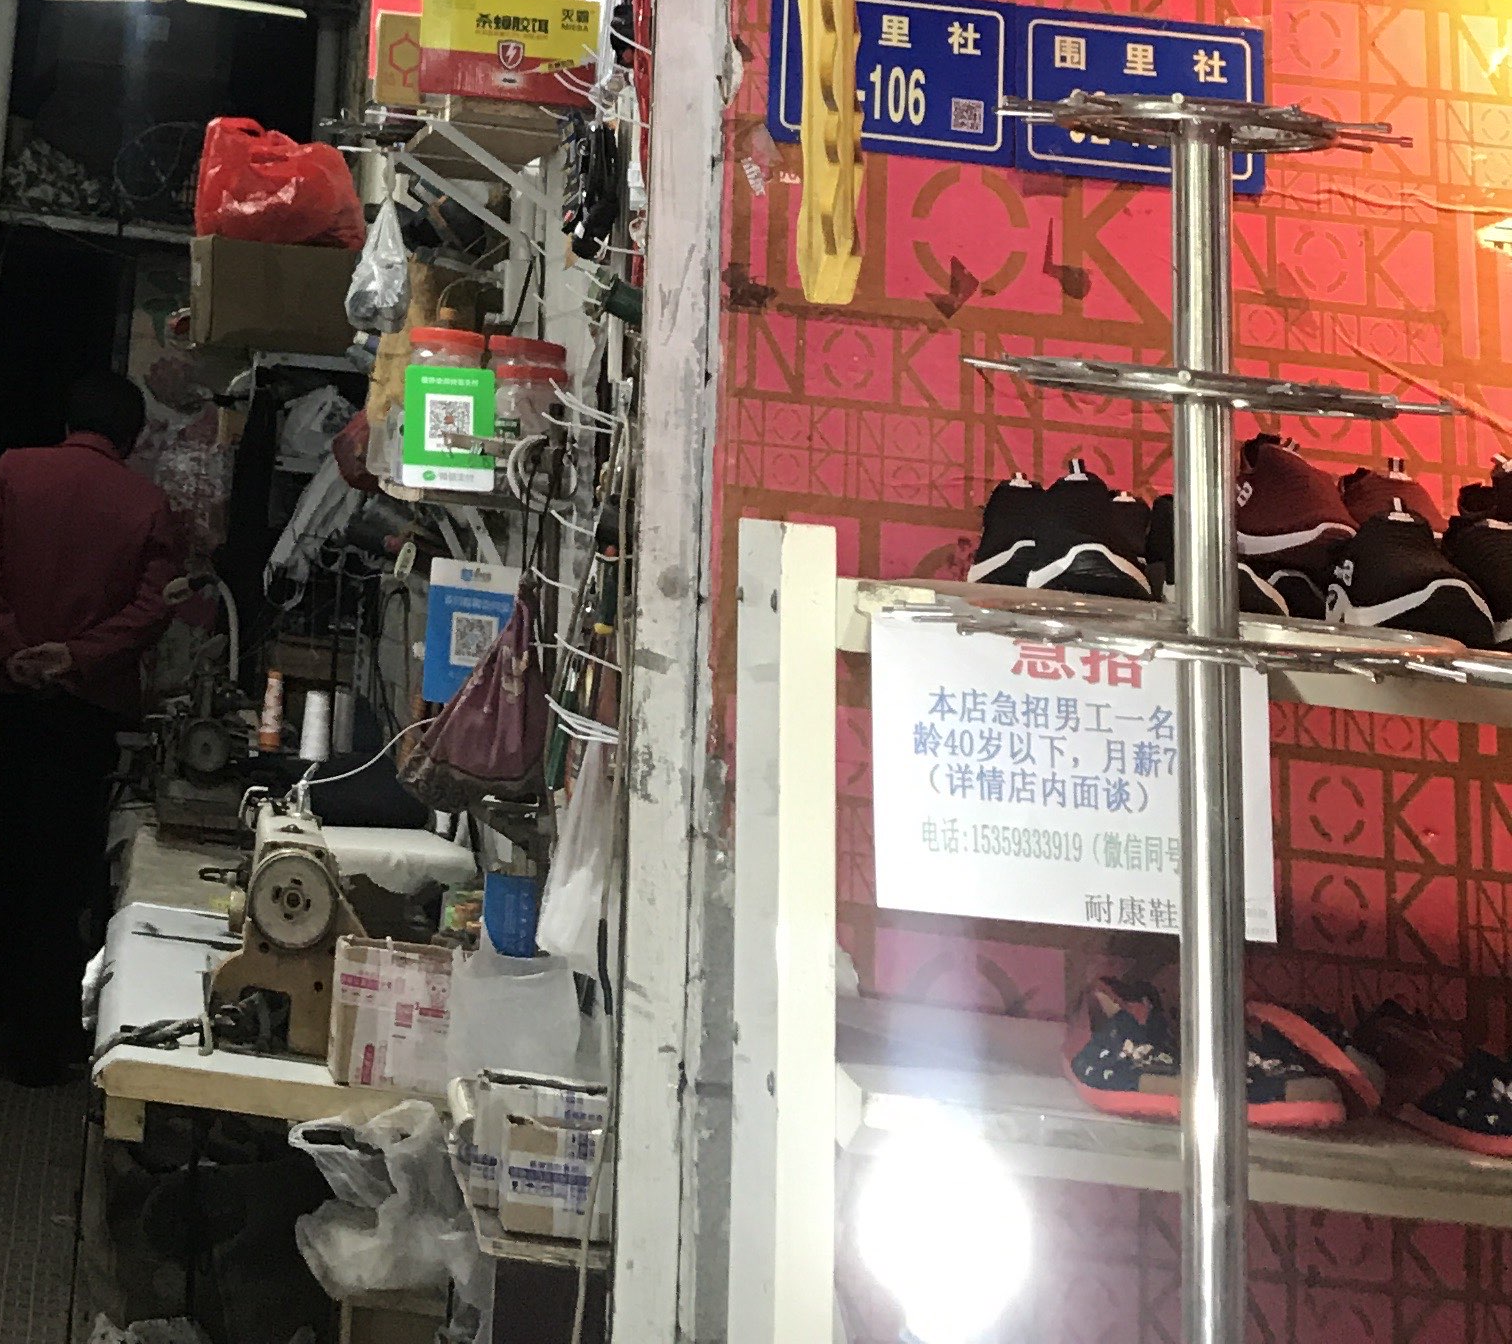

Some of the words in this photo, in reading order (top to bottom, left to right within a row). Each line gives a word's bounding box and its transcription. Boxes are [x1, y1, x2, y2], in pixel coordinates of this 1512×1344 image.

[877, 13, 982, 56] 里社
[1053, 34, 1228, 85] 围里社
